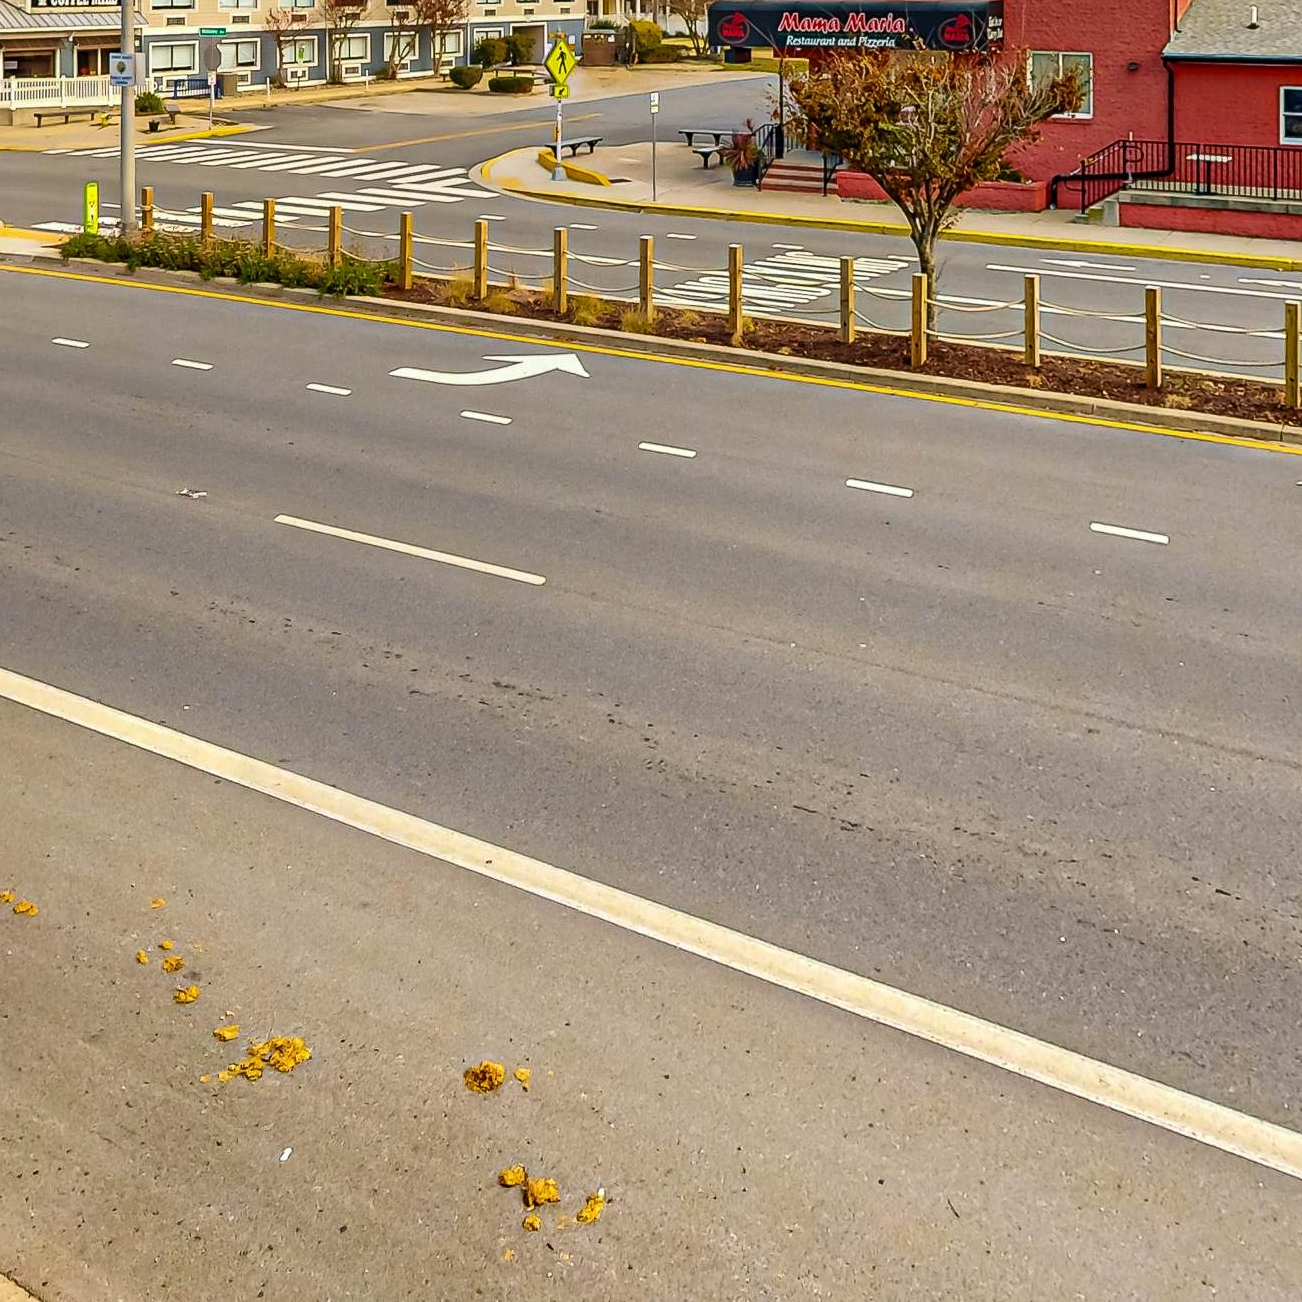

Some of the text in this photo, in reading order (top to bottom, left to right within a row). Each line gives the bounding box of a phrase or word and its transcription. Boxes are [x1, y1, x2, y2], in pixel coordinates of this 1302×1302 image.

[778, 12, 906, 34] Mama Maria
[786, 34, 896, 48] Restaurant and Pizzeria
